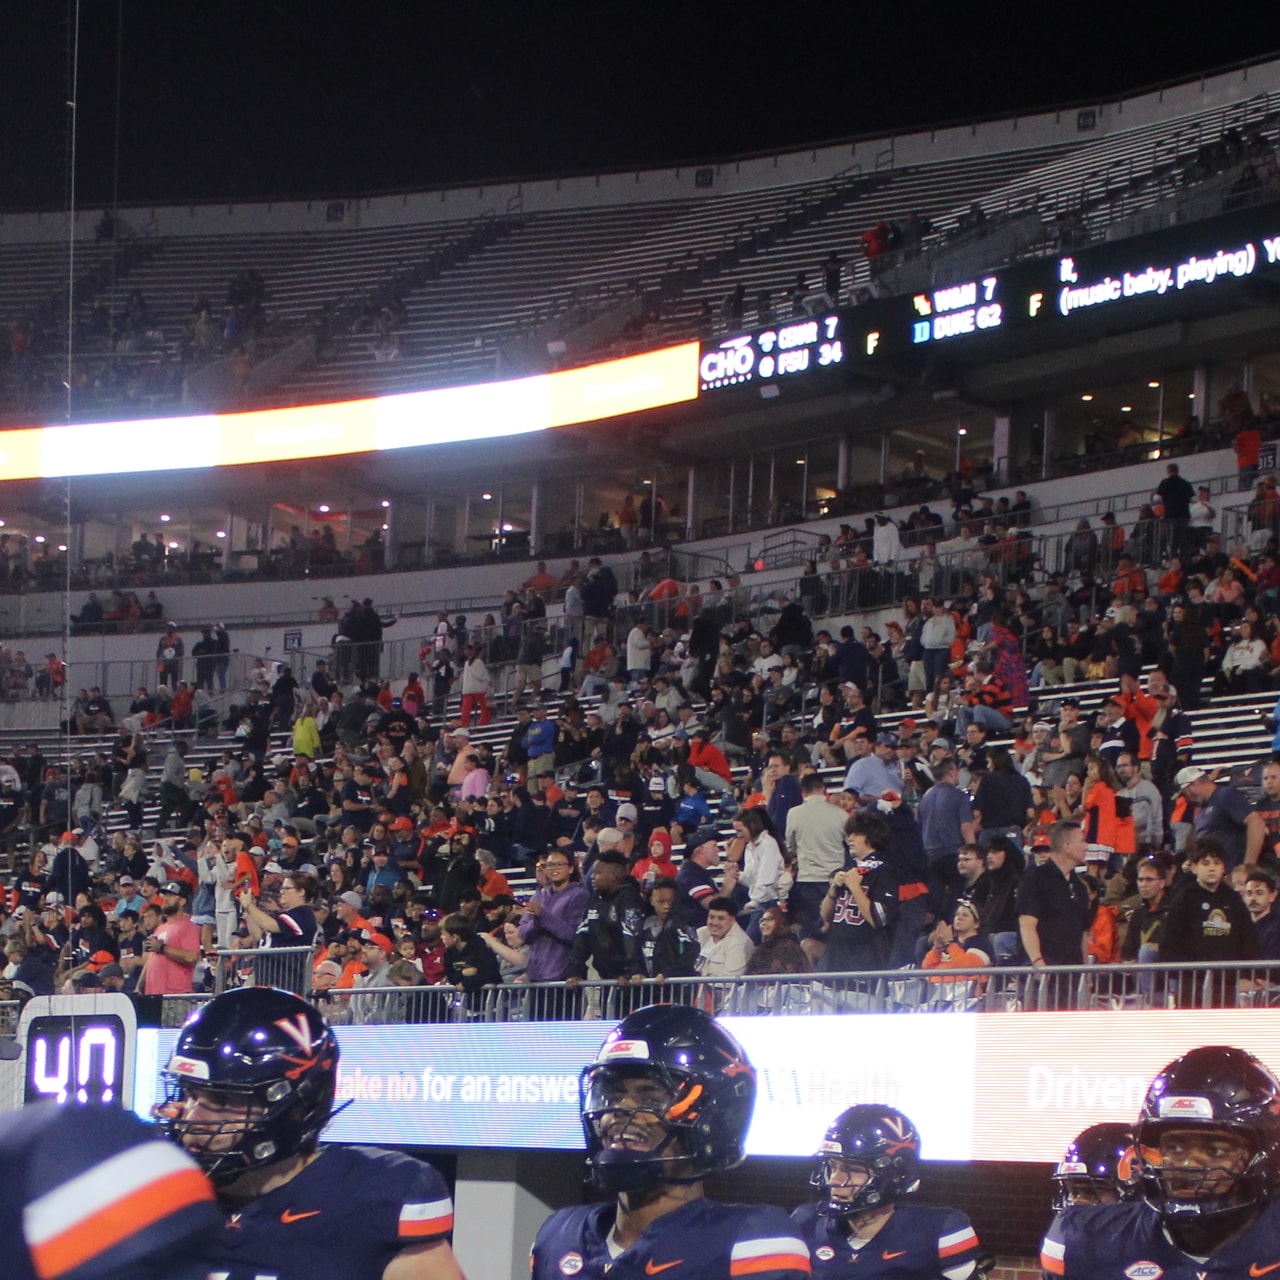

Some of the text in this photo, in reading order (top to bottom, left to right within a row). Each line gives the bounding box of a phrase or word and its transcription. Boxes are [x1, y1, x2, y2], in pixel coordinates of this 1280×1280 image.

[1176, 242, 1257, 290] playing)
[982, 276, 998, 301] 7
[1028, 292, 1043, 318] F
[824, 316, 839, 339] 7
[933, 309, 976, 340] DUKE
[976, 303, 1002, 329] 62
[777, 341, 843, 375] FSU 34
[866, 331, 880, 356] F
[700, 346, 755, 382] CHO
[386, 1074, 418, 1100] no
[421, 1065, 460, 1102] for
[460, 1075, 492, 1102] an
[495, 1075, 580, 1103] answe
